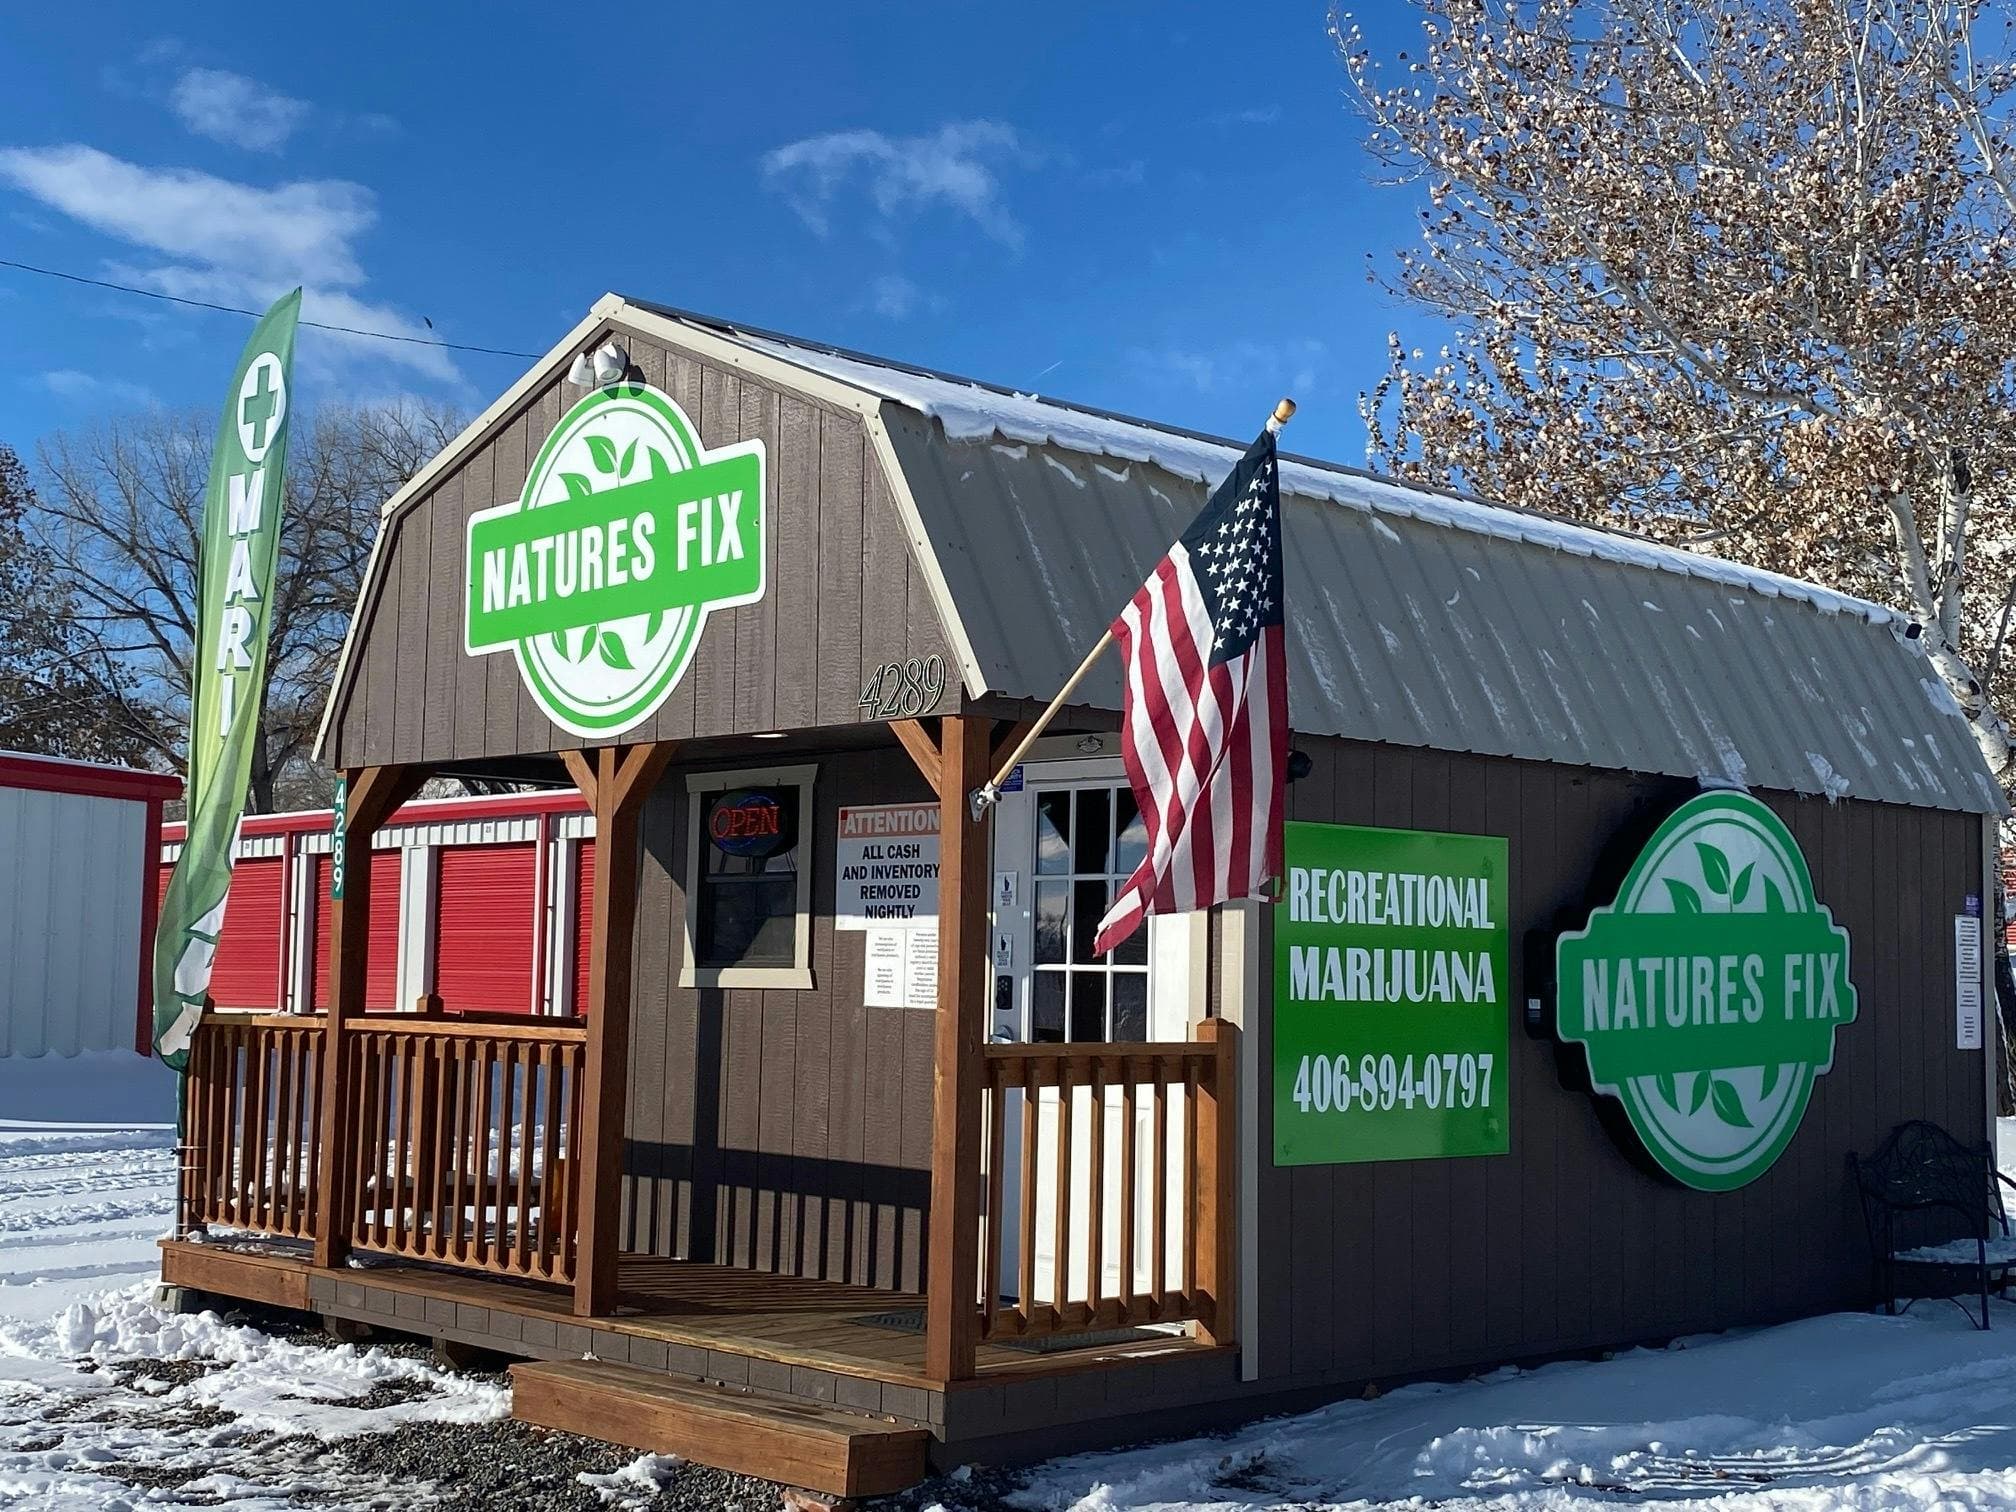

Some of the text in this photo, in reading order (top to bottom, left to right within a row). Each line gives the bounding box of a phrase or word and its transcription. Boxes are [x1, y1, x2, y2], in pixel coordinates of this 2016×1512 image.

[482, 489, 745, 614] NATURES FIX
[858, 654, 946, 720] 4289
[333, 783, 345, 893] 4289
[712, 805, 780, 838] OPEN
[844, 808, 940, 834] ATTENTION
[842, 863, 940, 880] AND INVENTORY
[862, 843, 920, 860] ALL CASH
[860, 884, 921, 900] REMOVED
[865, 904, 915, 919] NIGHTLY
[1290, 866, 1495, 929] RECREATIONAL
[1290, 945, 1496, 1003] MARIJUANA
[1583, 952, 1840, 1032] NATURES FIX
[1293, 1053, 1494, 1113] 406-894-0797
